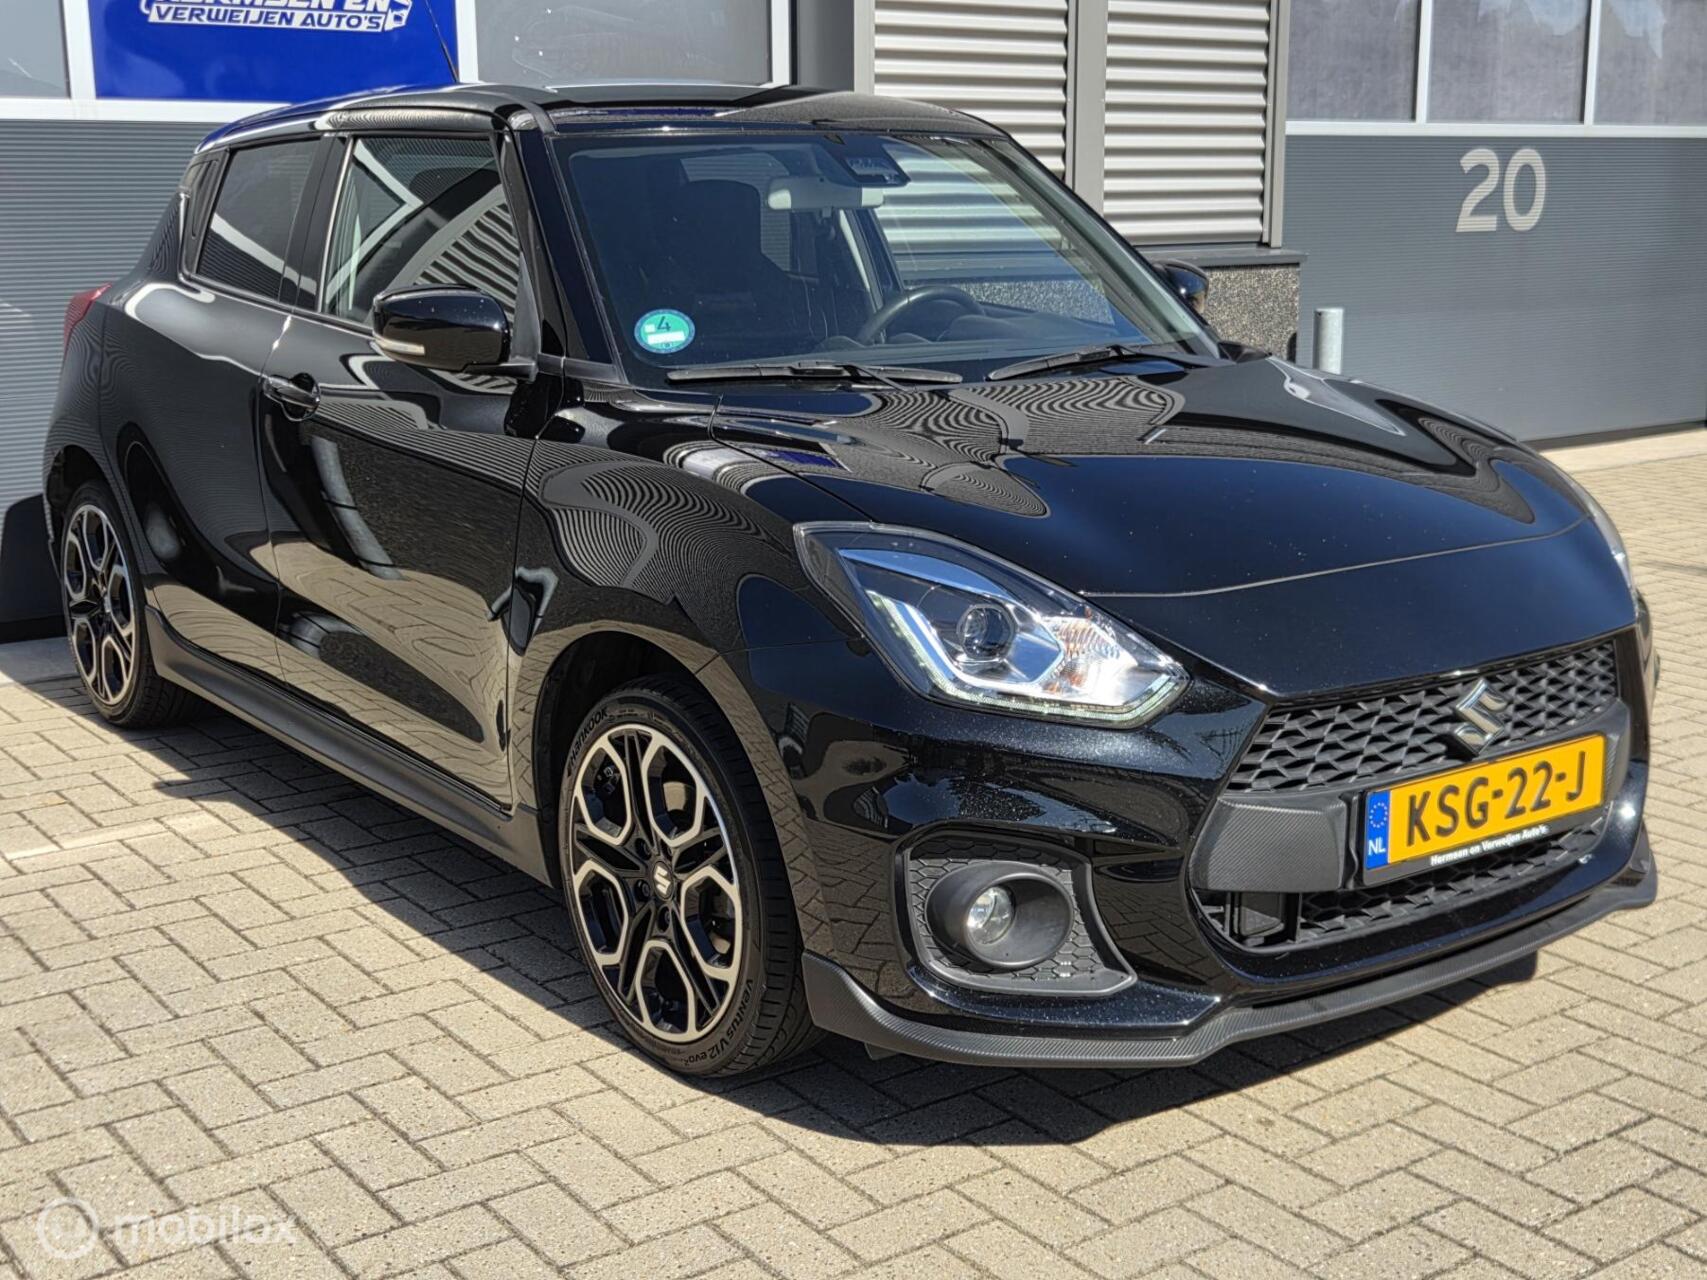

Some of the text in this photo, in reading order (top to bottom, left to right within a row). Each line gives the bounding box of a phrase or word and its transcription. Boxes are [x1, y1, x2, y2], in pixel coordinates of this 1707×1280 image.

[155, 6, 383, 29] VERWEIJEN AUTO'S
[1455, 148, 1546, 232] 20
[657, 315, 671, 332] 4
[1406, 751, 1586, 847] KSG-22-J
[1368, 836, 1386, 856] NL
